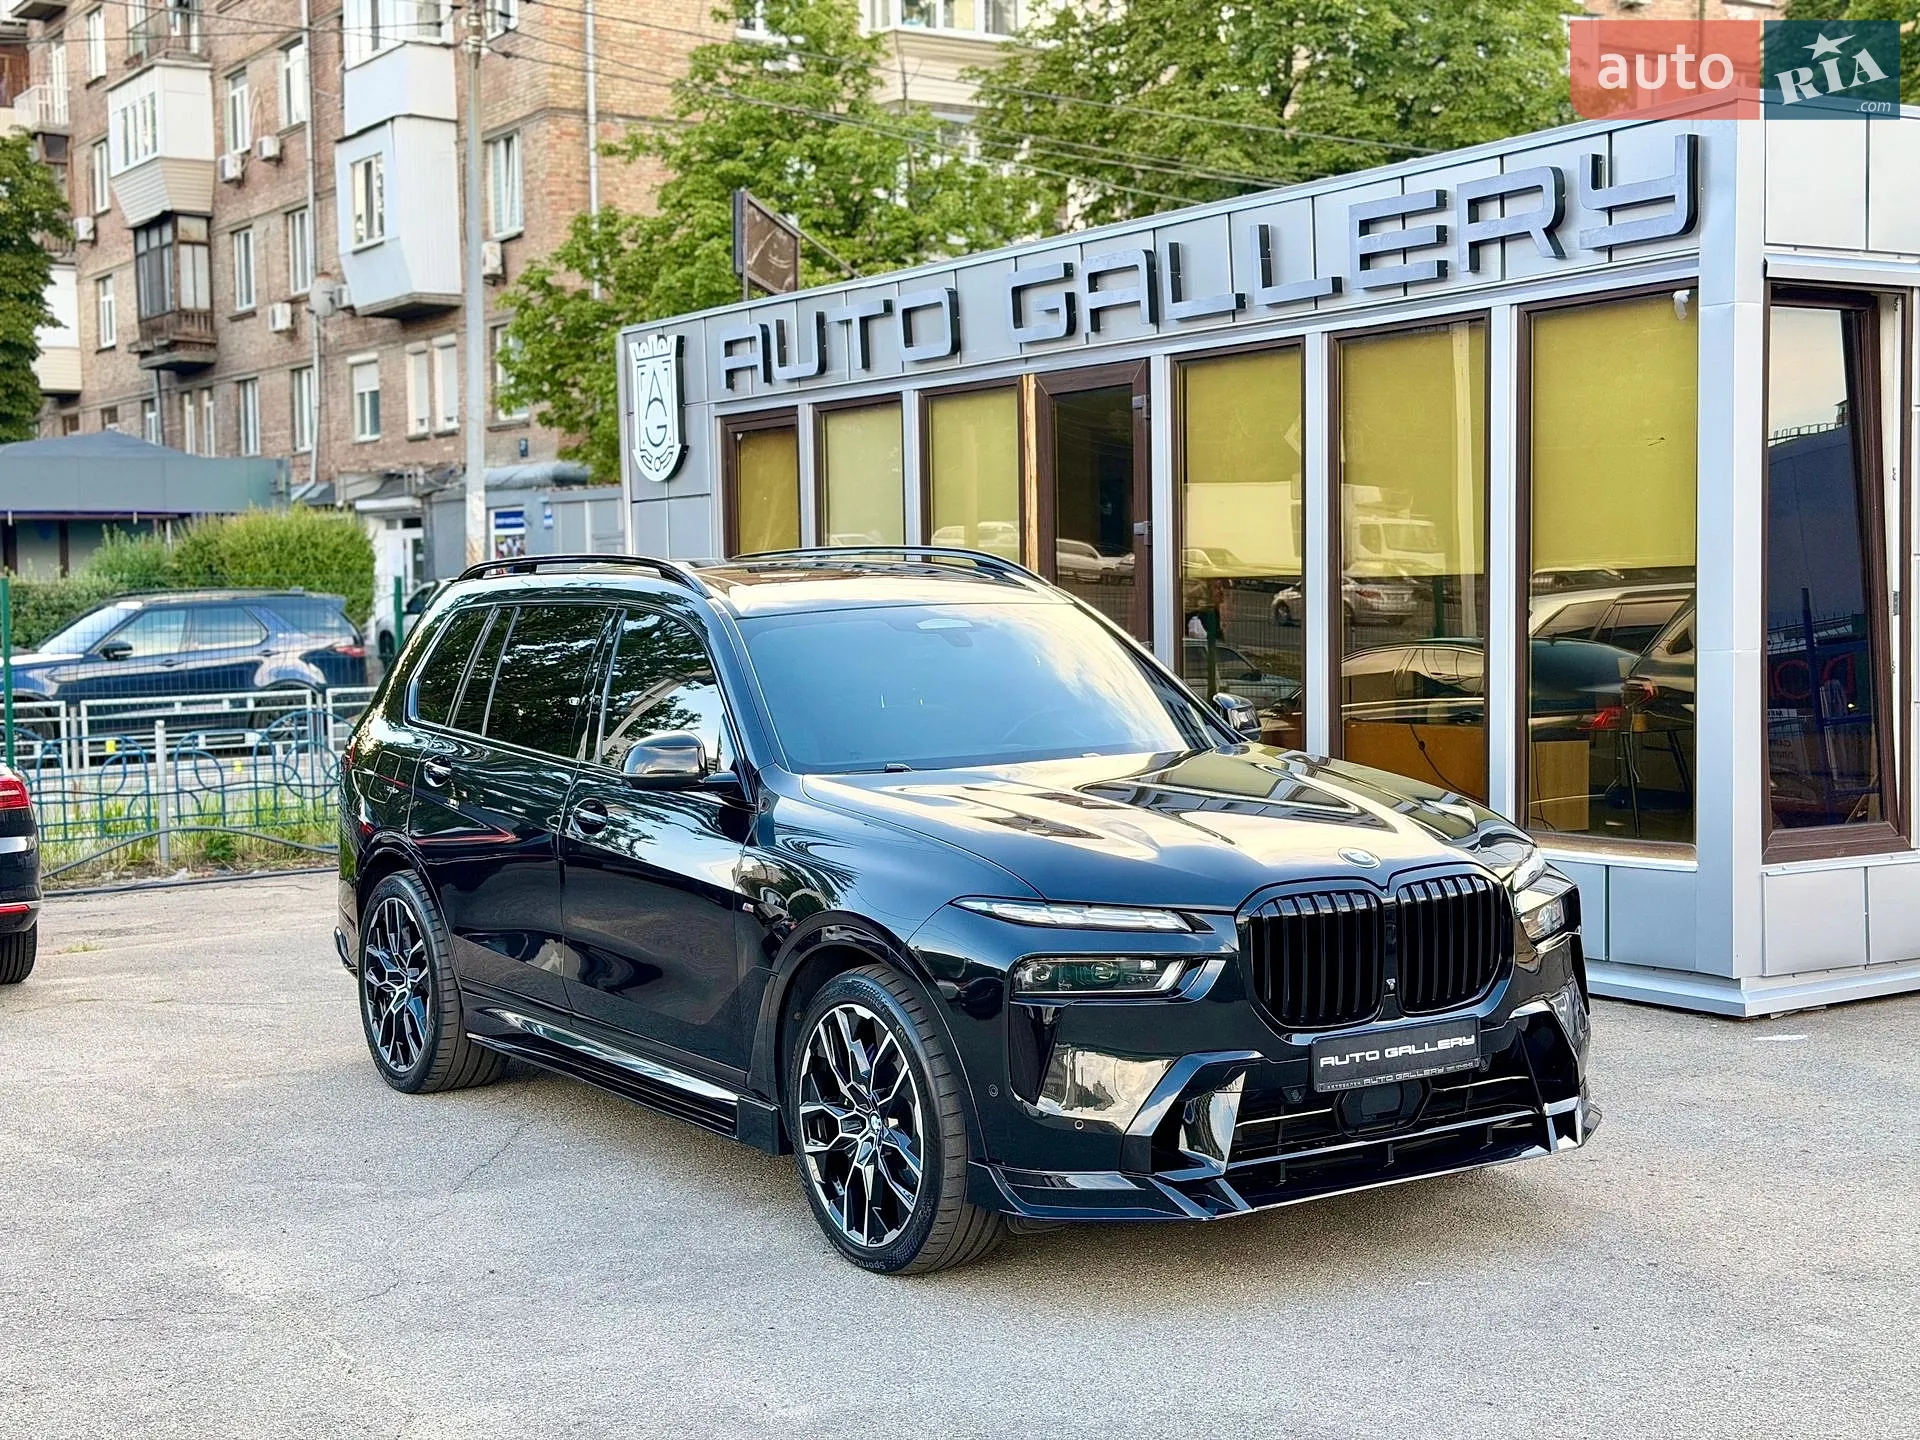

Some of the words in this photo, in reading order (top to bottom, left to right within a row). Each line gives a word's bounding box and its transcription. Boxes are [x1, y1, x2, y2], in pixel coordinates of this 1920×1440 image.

[719, 287, 961, 392] AUTO
[1005, 133, 1700, 344] GALLERY
[1319, 1050, 1380, 1068] AUTO
[1384, 1034, 1475, 1059] GALLERY
[1363, 1074, 1394, 1086] AUTO
[1395, 1066, 1445, 1081] GALLERY
